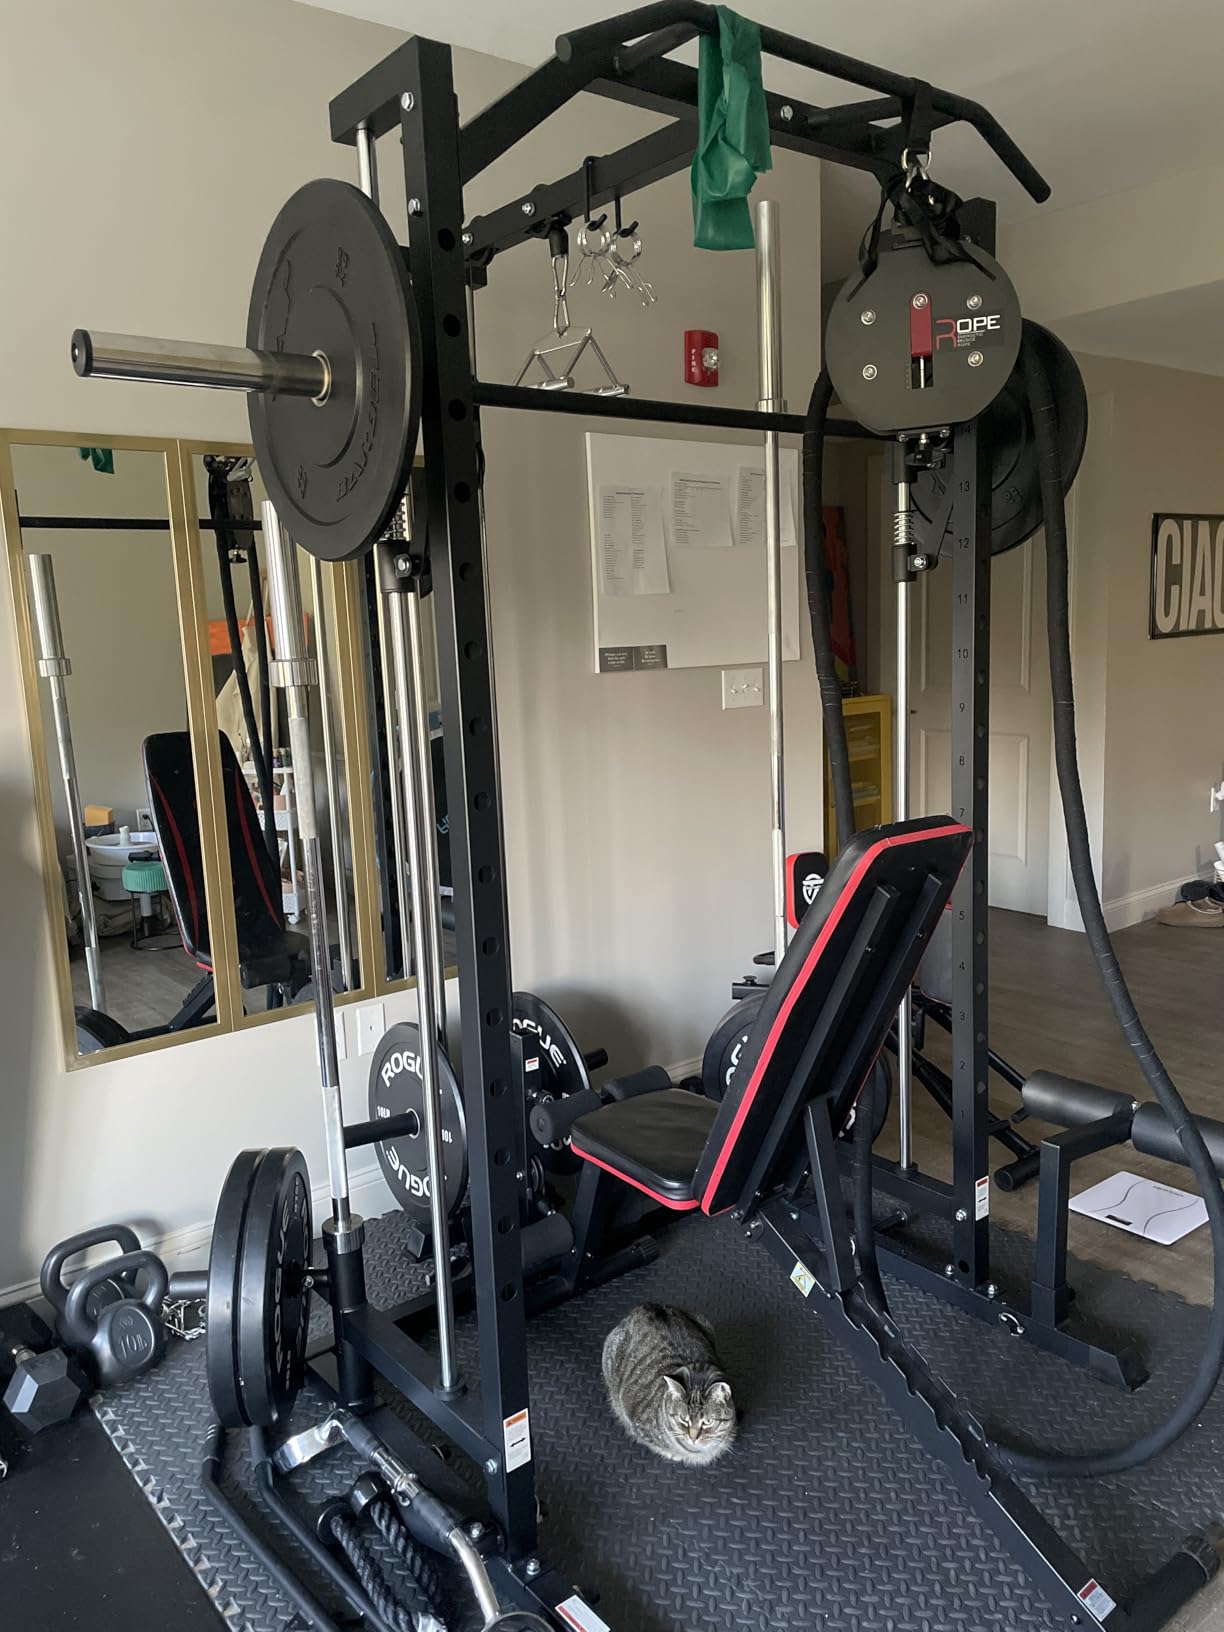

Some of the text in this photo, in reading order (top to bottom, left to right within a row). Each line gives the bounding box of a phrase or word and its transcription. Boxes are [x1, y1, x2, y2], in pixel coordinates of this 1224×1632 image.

[936, 314, 1001, 351] ROPE
[959, 480, 970, 493] 13
[958, 538, 970, 550] 12
[958, 593, 968, 605] 11
[957, 648, 969, 659] 10
[959, 702, 966, 713] 9
[959, 755, 966, 766] 8
[959, 807, 966, 818] 7
[959, 910, 966, 921] 5
[959, 961, 966, 971] 4
[959, 1010, 966, 1021] 3
[959, 1060, 966, 1071] 2
[274, 1199, 291, 1375] ROGUE
